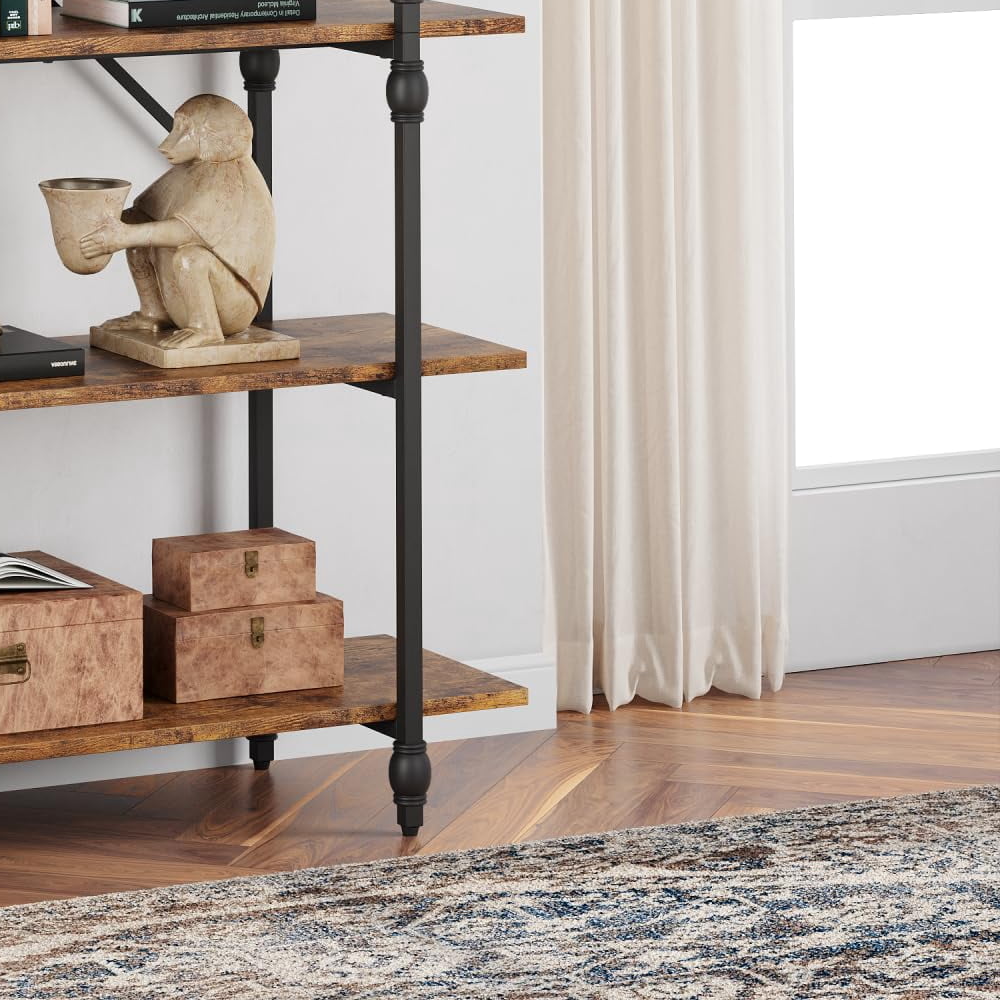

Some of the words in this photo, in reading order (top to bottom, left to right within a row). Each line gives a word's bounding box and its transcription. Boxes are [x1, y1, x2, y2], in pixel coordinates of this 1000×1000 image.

[257, 0, 279, 8] McLeod
[280, 0, 300, 7] Virginia
[176, 13, 209, 21] Architecture
[210, 12, 239, 20] Residential
[240, 10, 278, 18] Contemporary
